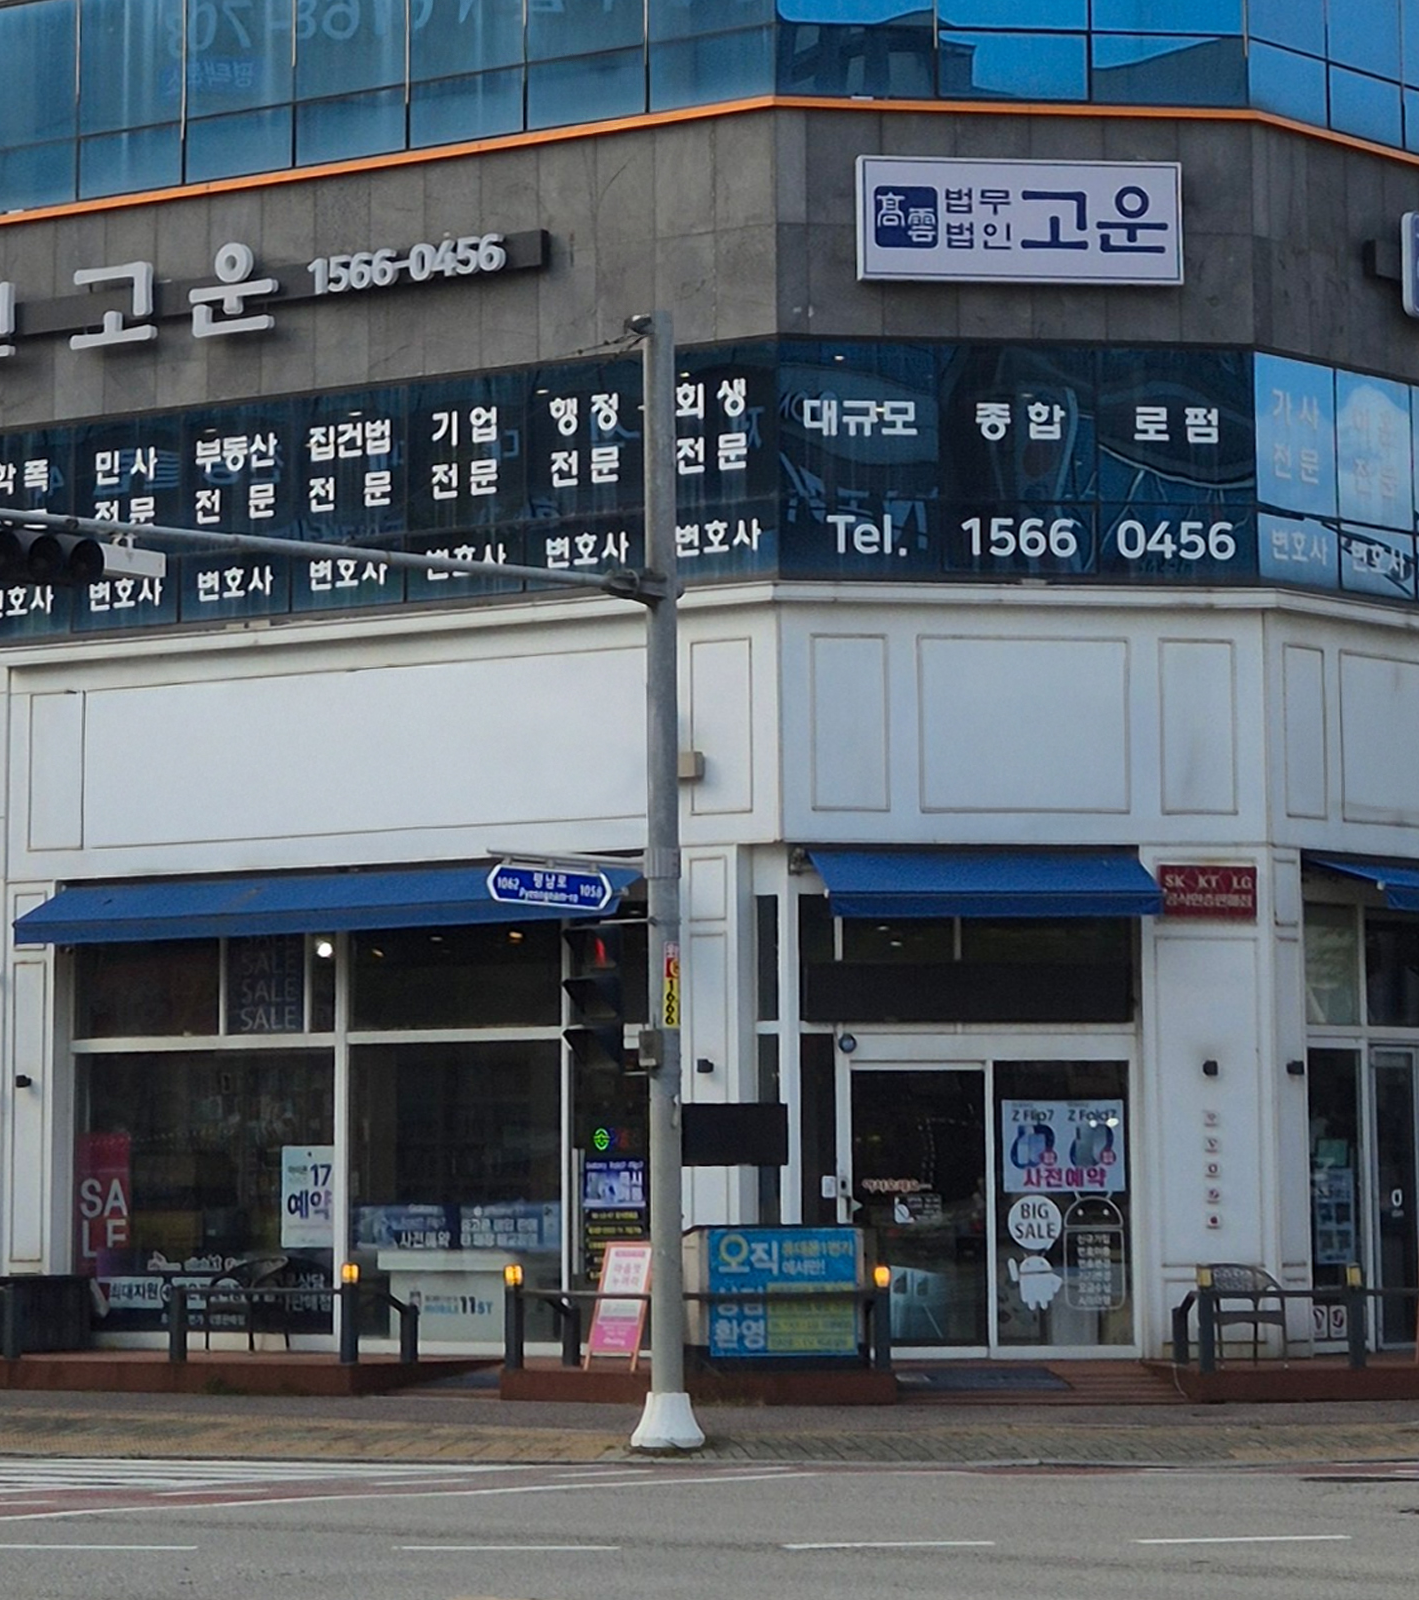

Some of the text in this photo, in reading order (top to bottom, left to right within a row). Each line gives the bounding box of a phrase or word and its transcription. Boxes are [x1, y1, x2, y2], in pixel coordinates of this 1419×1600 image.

[945, 188, 1011, 215] 법무
[1021, 186, 1169, 253] 고운
[945, 222, 1012, 250] 법인
[69, 242, 280, 353] 고운
[307, 232, 507, 296] 1566-0456
[549, 392, 620, 437] 행정
[676, 376, 747, 420] 회생
[1271, 388, 1320, 430] 가사
[309, 418, 392, 462] 집건법
[432, 405, 498, 447] 기업
[803, 400, 1220, 444] 대규모 종합 로펌
[95, 446, 158, 485] 민사
[195, 432, 277, 474] 부동산
[550, 444, 621, 488] 전문
[677, 432, 748, 475] 전문
[1274, 442, 1321, 486] 전문
[309, 468, 392, 512] 전문
[432, 457, 499, 500] 전문
[195, 482, 276, 525] 전문
[545, 530, 630, 569] 변호사
[675, 517, 762, 558] 변호사
[827, 514, 1237, 560] Tel. 1566 0456
[1271, 529, 1328, 566] 변호사
[89, 576, 163, 612] 변호사
[197, 564, 274, 602] 변호사
[309, 556, 388, 592] 변호사
[1165, 875, 1253, 890] SK KT LG
[241, 1003, 297, 1031] SALE
[310, 1163, 333, 1187] 17
[1024, 1167, 1106, 1188] 사전예약
[80, 1178, 128, 1218] SA
[287, 1189, 333, 1220] 예약
[1021, 1203, 1049, 1219] BIG
[1014, 1223, 1057, 1239] SALE
[718, 1234, 779, 1277] 오직
[714, 1318, 766, 1349] 환영
